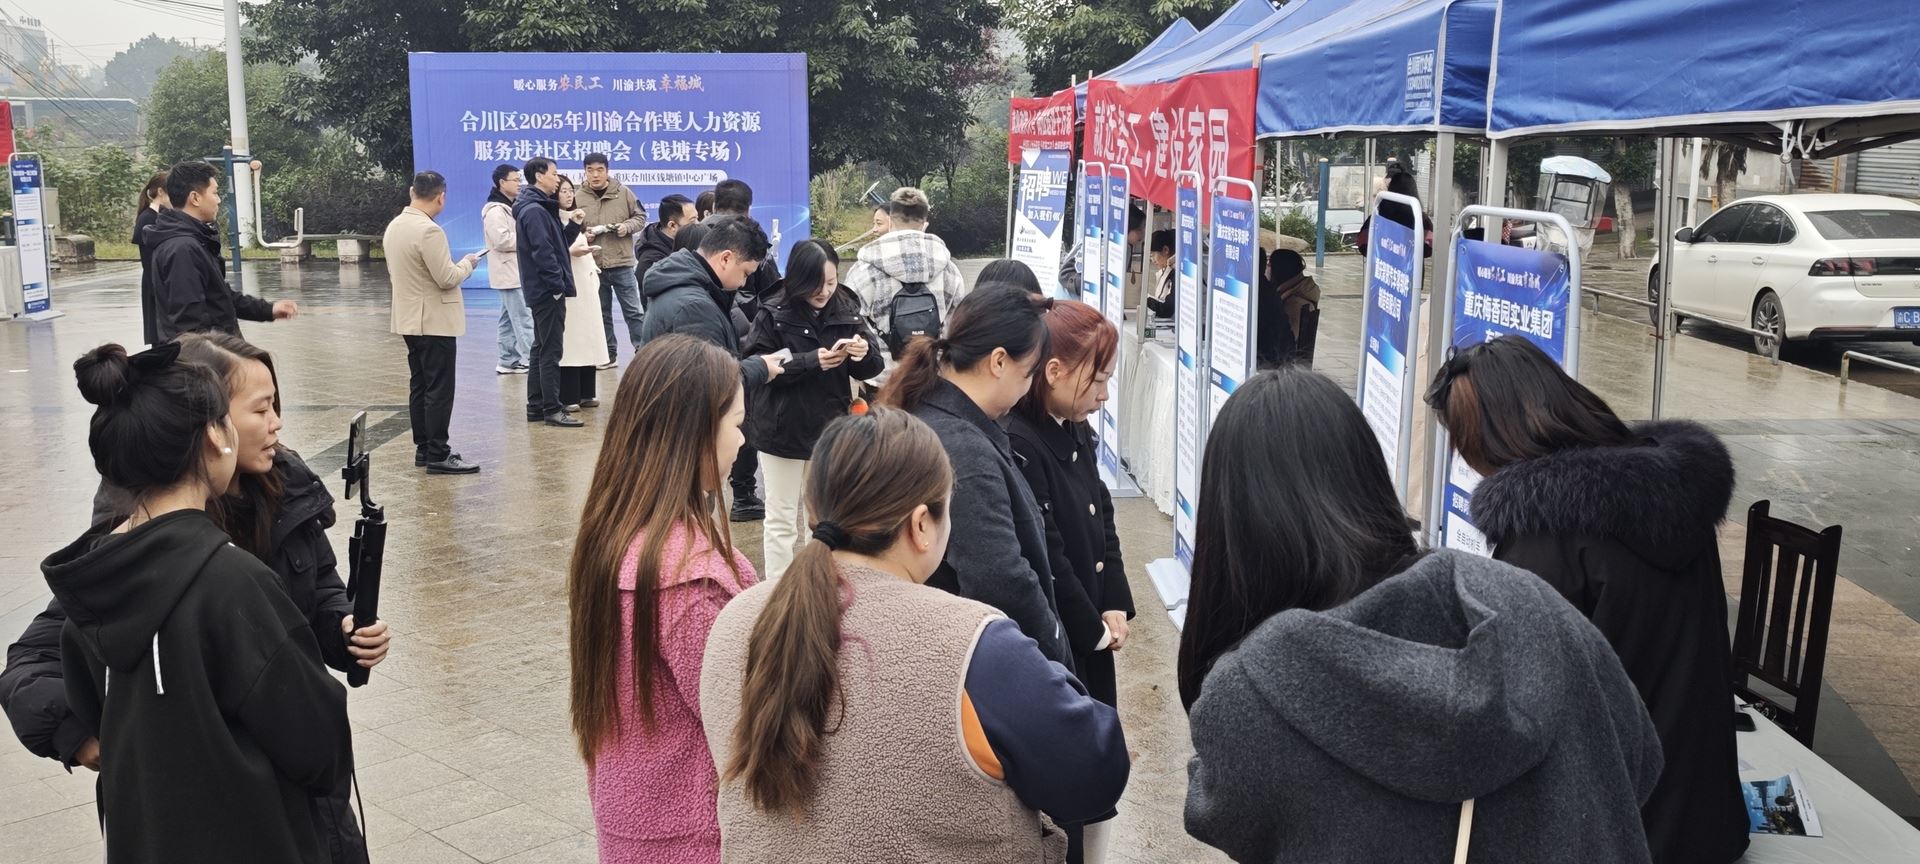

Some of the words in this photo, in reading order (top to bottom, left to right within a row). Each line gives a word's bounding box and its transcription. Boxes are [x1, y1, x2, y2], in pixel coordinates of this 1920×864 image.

[513, 74, 604, 92] 暖心服务农民工
[612, 74, 705, 93] 川渝共筑幸福城
[460, 110, 761, 133] 合川区2025年川渝合作暨人力资源
[474, 140, 743, 162] 服务进社区招聘会（钱塘专场）
[612, 171, 719, 185] 重庆合川区钱塘镇中心广场
[1020, 166, 1050, 201] 招聘
[1052, 171, 1067, 185] WE
[1027, 209, 1052, 221] 加入我们
[1463, 291, 1554, 339] 重庆梅香园实业集团
